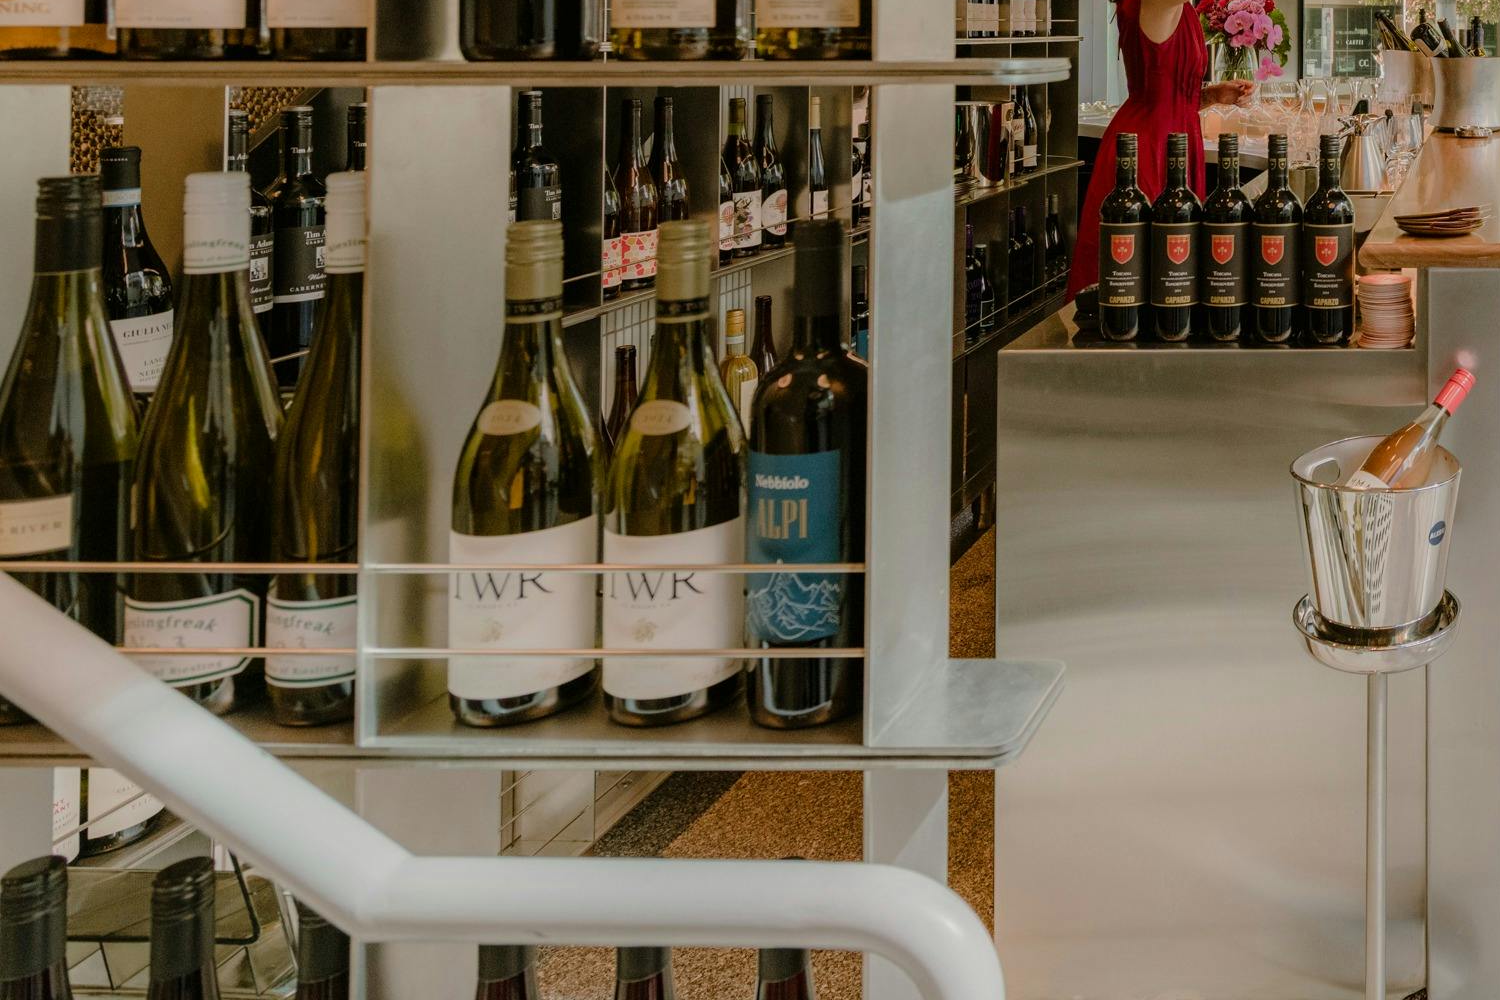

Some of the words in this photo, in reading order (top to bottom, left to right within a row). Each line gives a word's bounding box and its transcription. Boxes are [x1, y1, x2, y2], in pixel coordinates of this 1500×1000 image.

[303, 230, 321, 239] Tim
[754, 473, 810, 490] Nebbiolo
[756, 499, 808, 539] ALPI
